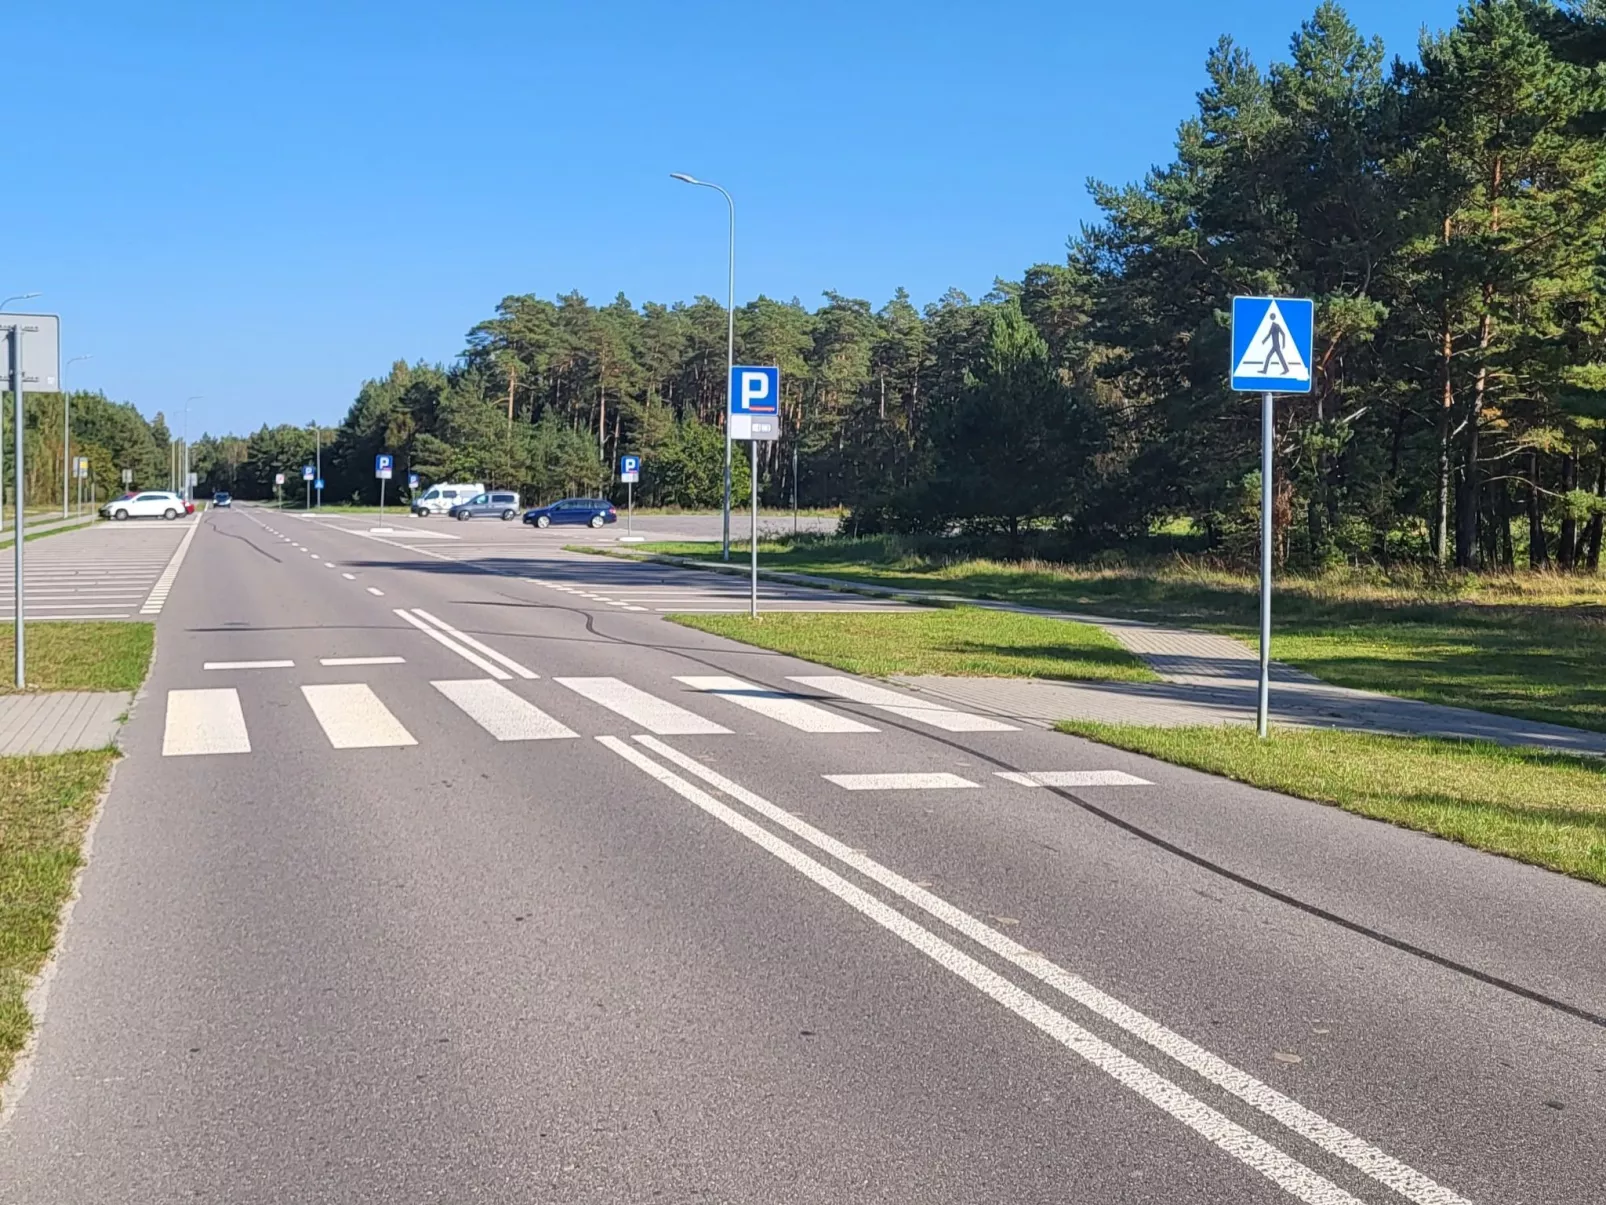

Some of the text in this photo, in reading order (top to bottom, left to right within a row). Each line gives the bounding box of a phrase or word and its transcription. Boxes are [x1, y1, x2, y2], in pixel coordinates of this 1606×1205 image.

[742, 372, 769, 409] P
[380, 457, 389, 470] P
[625, 458, 636, 472] P
